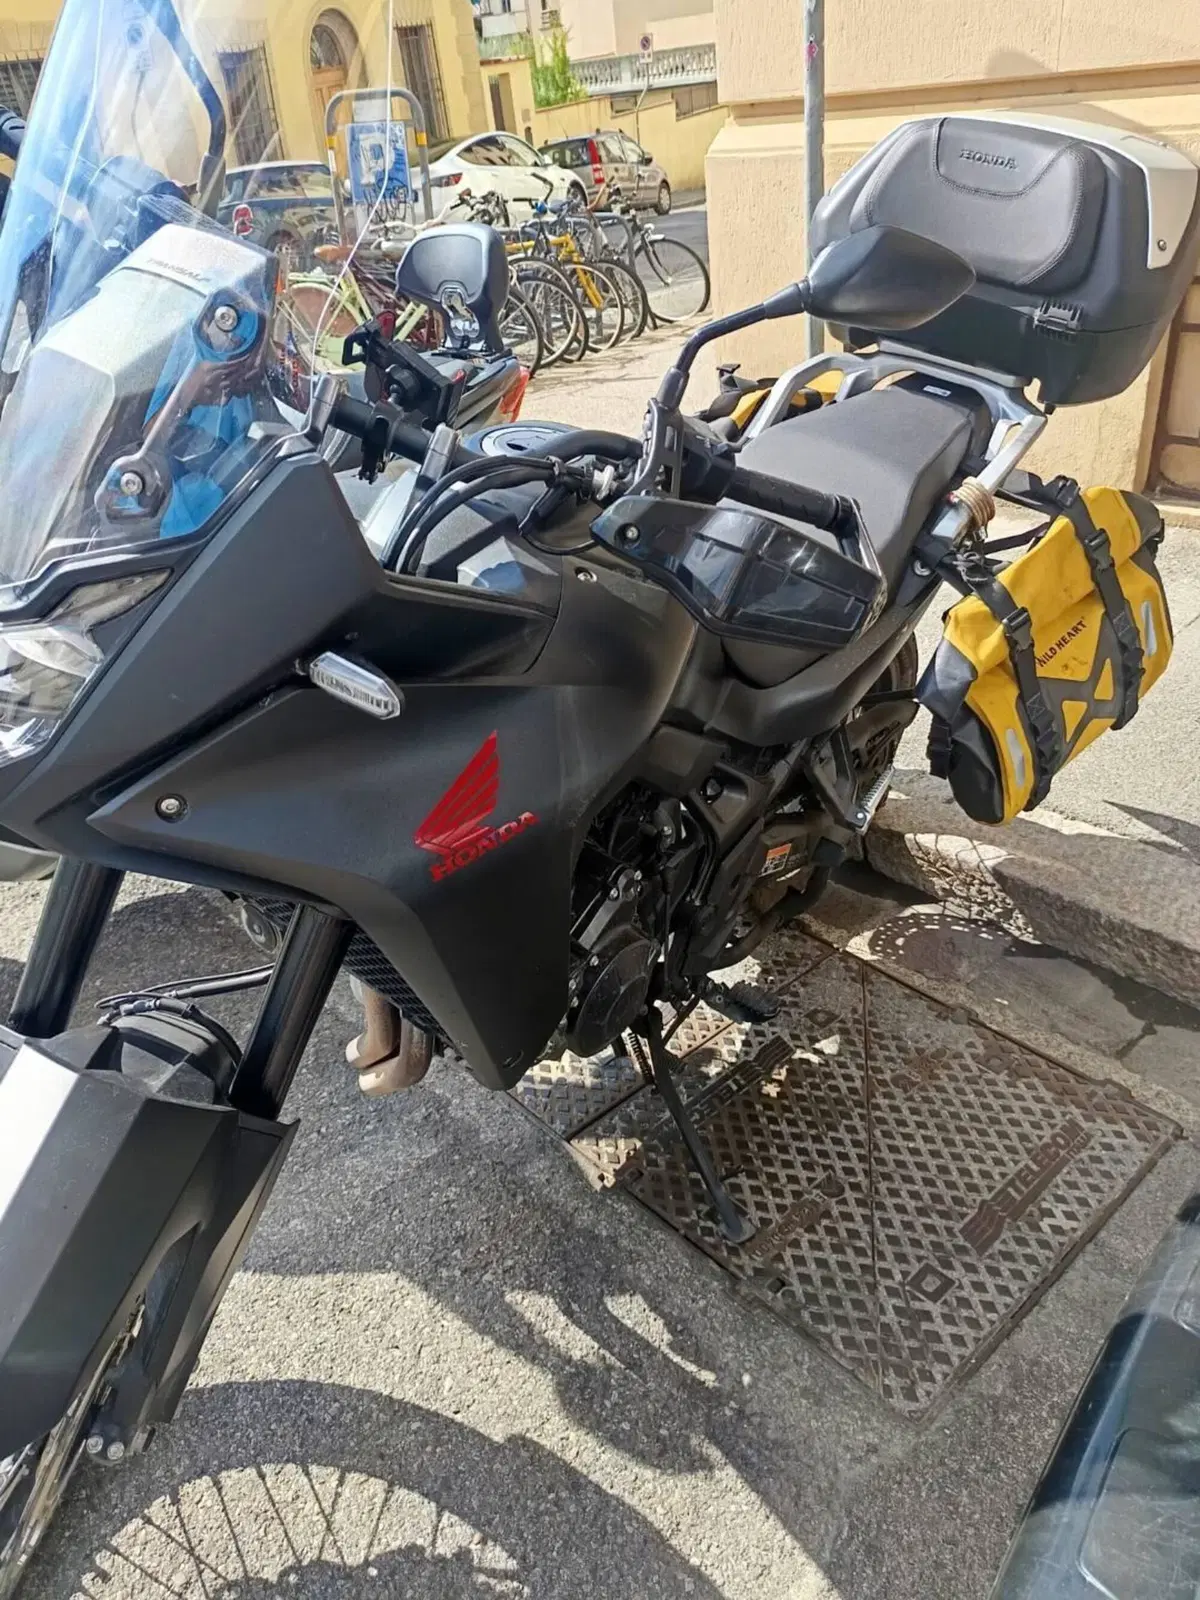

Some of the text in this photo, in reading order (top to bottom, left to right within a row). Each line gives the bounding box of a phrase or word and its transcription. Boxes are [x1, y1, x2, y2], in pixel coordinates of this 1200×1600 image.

[959, 148, 1017, 170] HONDA
[1055, 620, 1087, 651] HEART
[430, 811, 538, 882] HONDA
[1003, 1118, 1085, 1200] TELECOM
